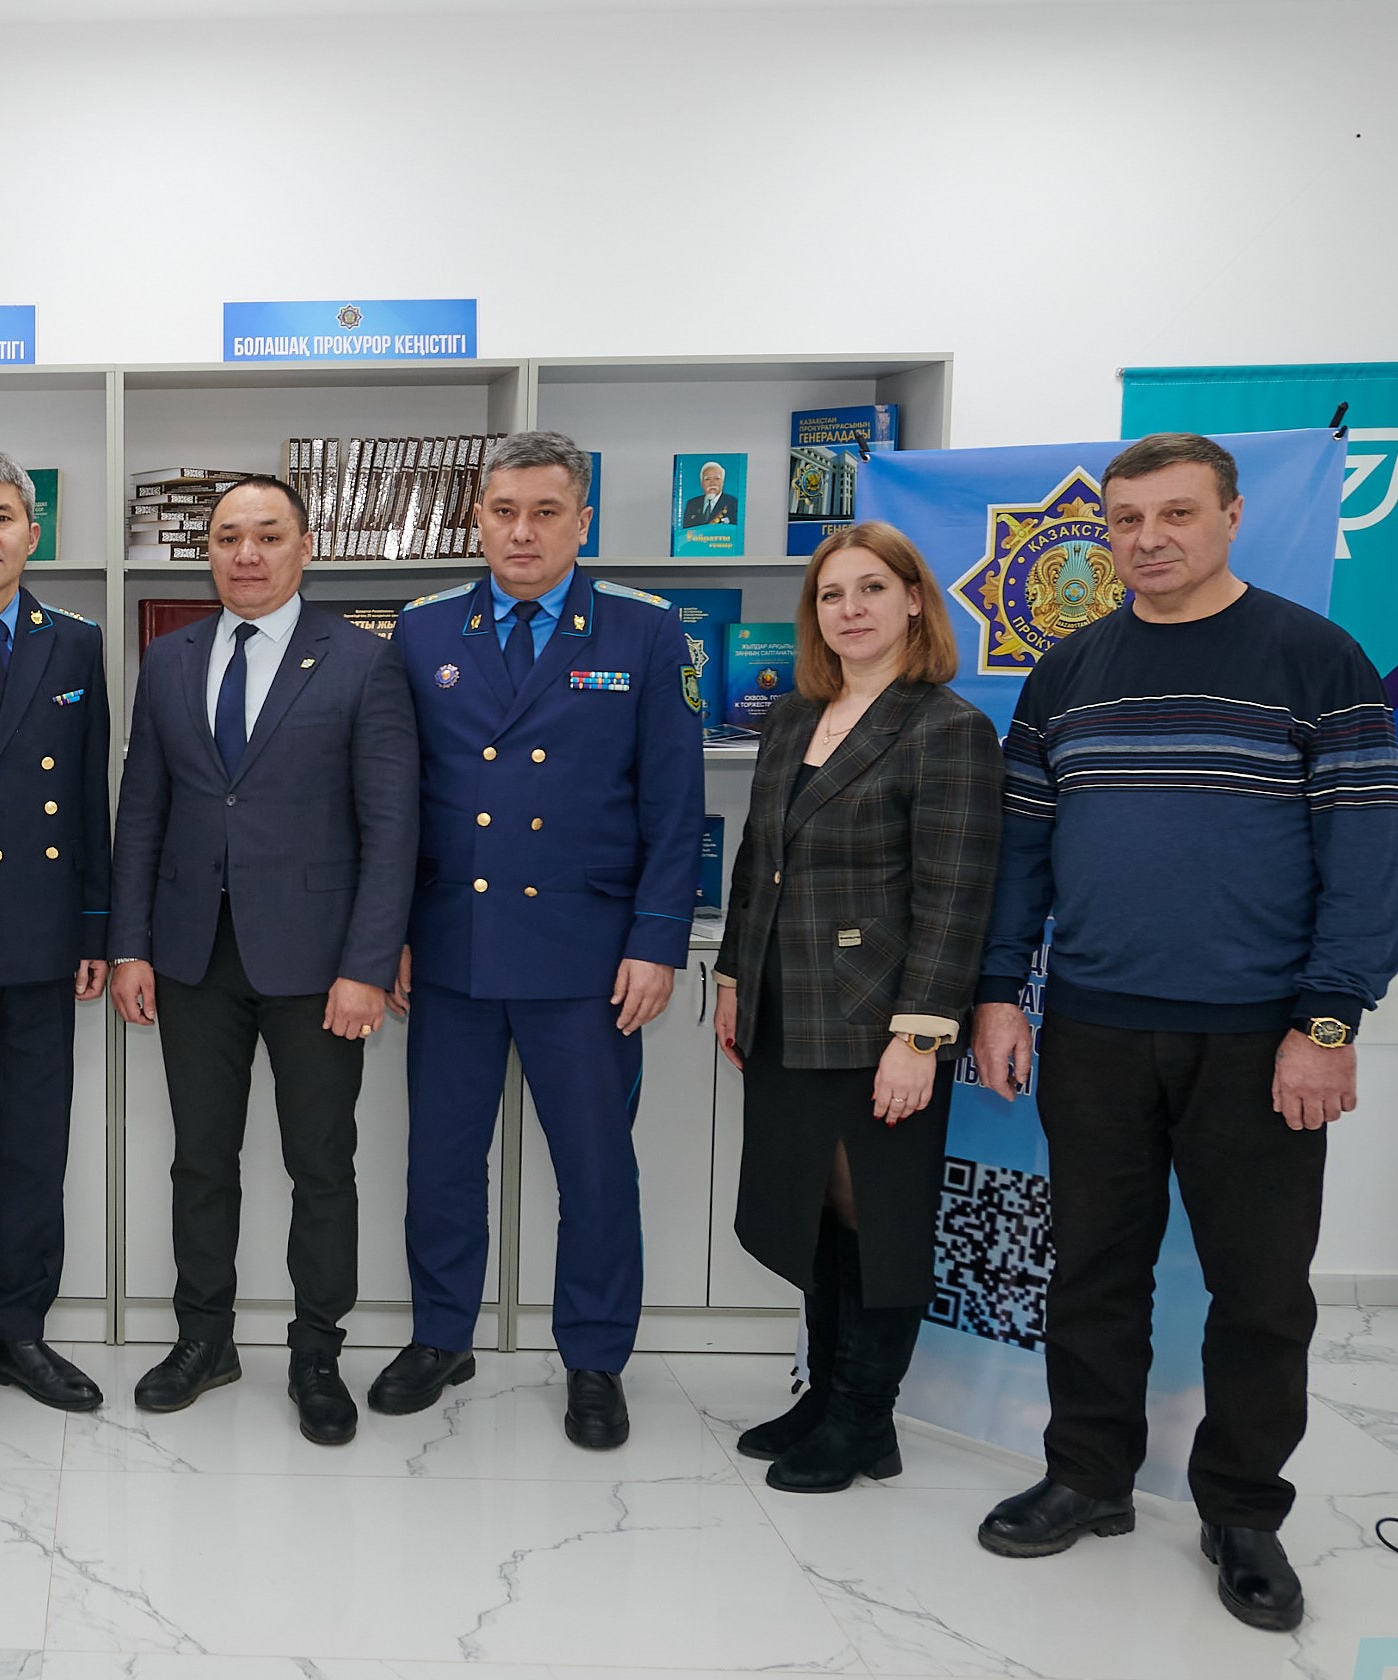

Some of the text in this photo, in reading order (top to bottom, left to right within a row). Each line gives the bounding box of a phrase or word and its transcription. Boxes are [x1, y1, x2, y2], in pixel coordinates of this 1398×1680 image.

[234, 334, 466, 357] БОЛАШАҚ ПРОКУРОР КЕҢІСТІГІ
[1028, 524, 1110, 552] ҚАЗАҚСТА
[1013, 616, 1055, 651] ПРОКУ
